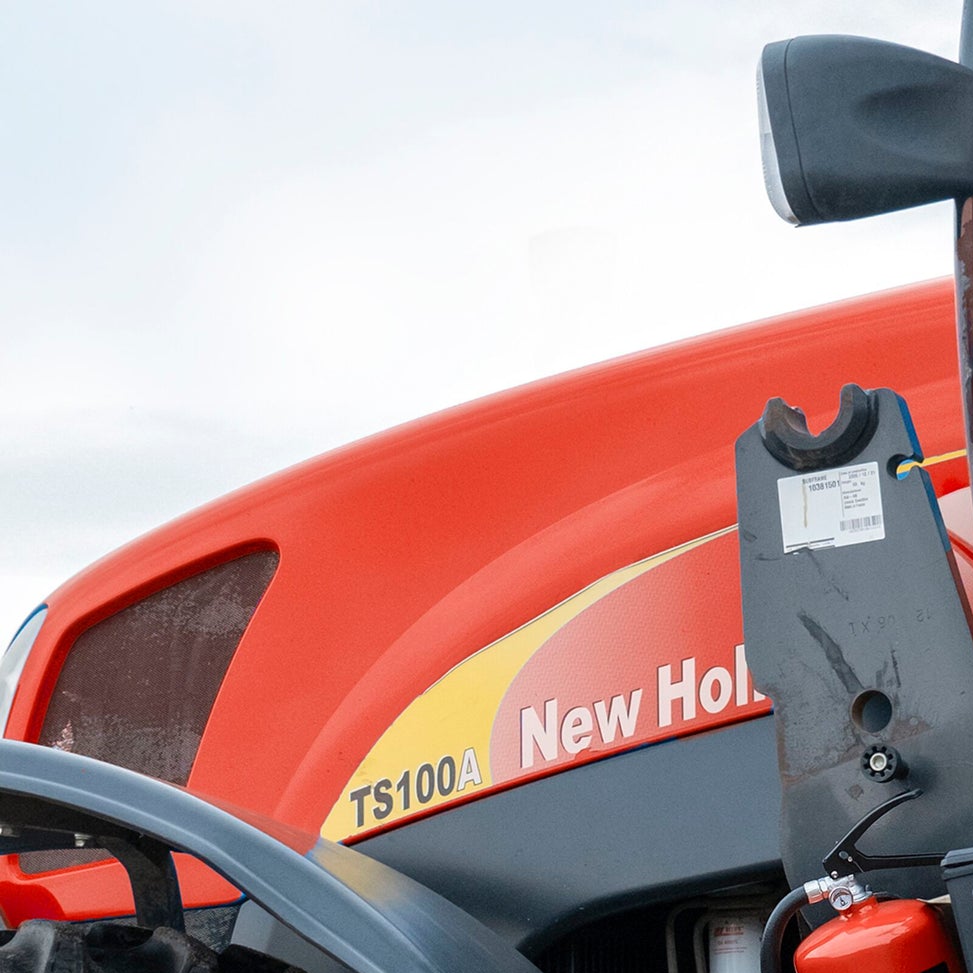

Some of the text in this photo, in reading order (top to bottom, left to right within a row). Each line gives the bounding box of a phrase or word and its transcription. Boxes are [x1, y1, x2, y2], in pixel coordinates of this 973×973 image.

[808, 480, 841, 492] 10381501
[519, 643, 767, 769] New Hol
[349, 748, 483, 828] TS100A
